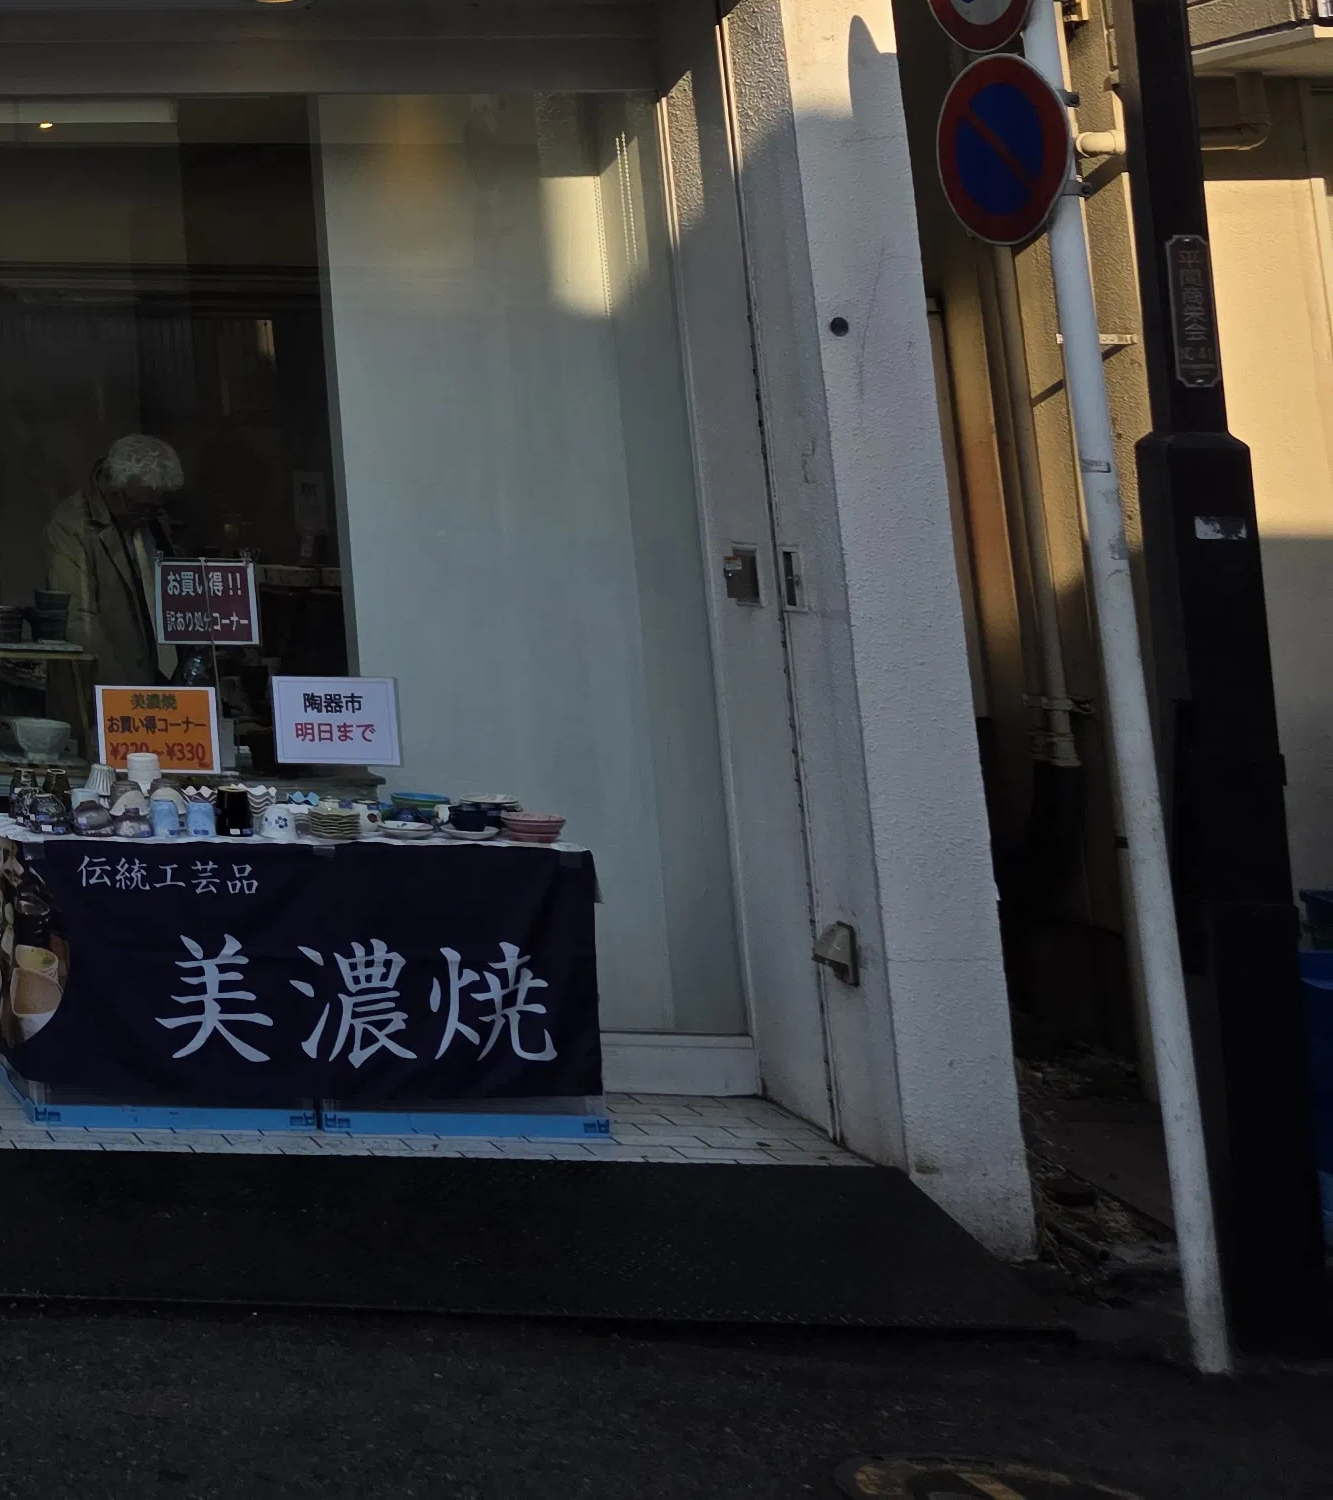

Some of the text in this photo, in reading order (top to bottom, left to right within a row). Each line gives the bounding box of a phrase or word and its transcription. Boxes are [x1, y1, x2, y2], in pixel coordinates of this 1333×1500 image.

[303, 692, 363, 713] 陶器市
[107, 716, 207, 734] お買い得コーナー
[295, 722, 376, 742] 明日まで
[76, 854, 260, 896] 伝統工芸品
[154, 932, 558, 1069] 美濃焼
